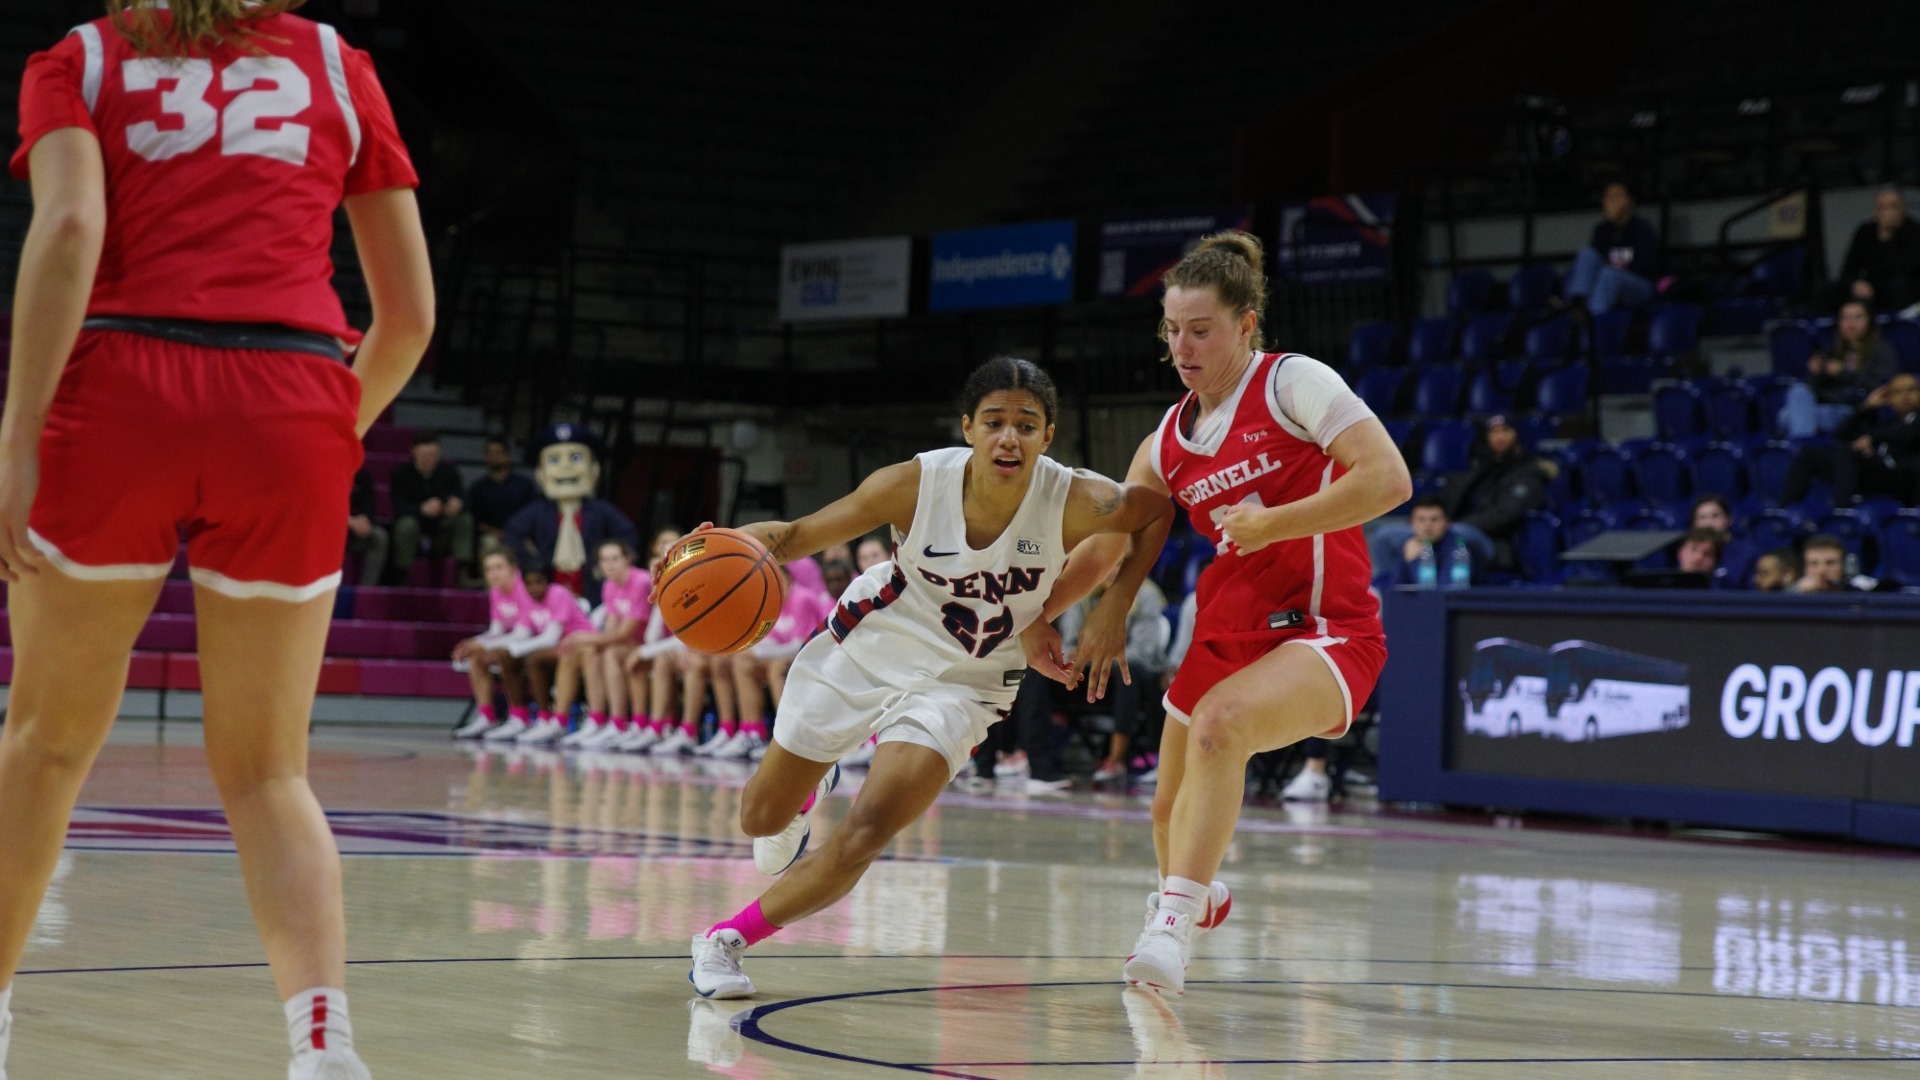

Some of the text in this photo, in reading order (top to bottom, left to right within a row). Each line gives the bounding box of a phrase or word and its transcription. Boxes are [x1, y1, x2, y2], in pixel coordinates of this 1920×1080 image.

[122, 57, 311, 166] 32
[1243, 431, 1260, 443] Ivy
[1178, 452, 1282, 507] CORNELL
[1023, 543, 1041, 551] IVY
[917, 566, 1046, 604] PENN
